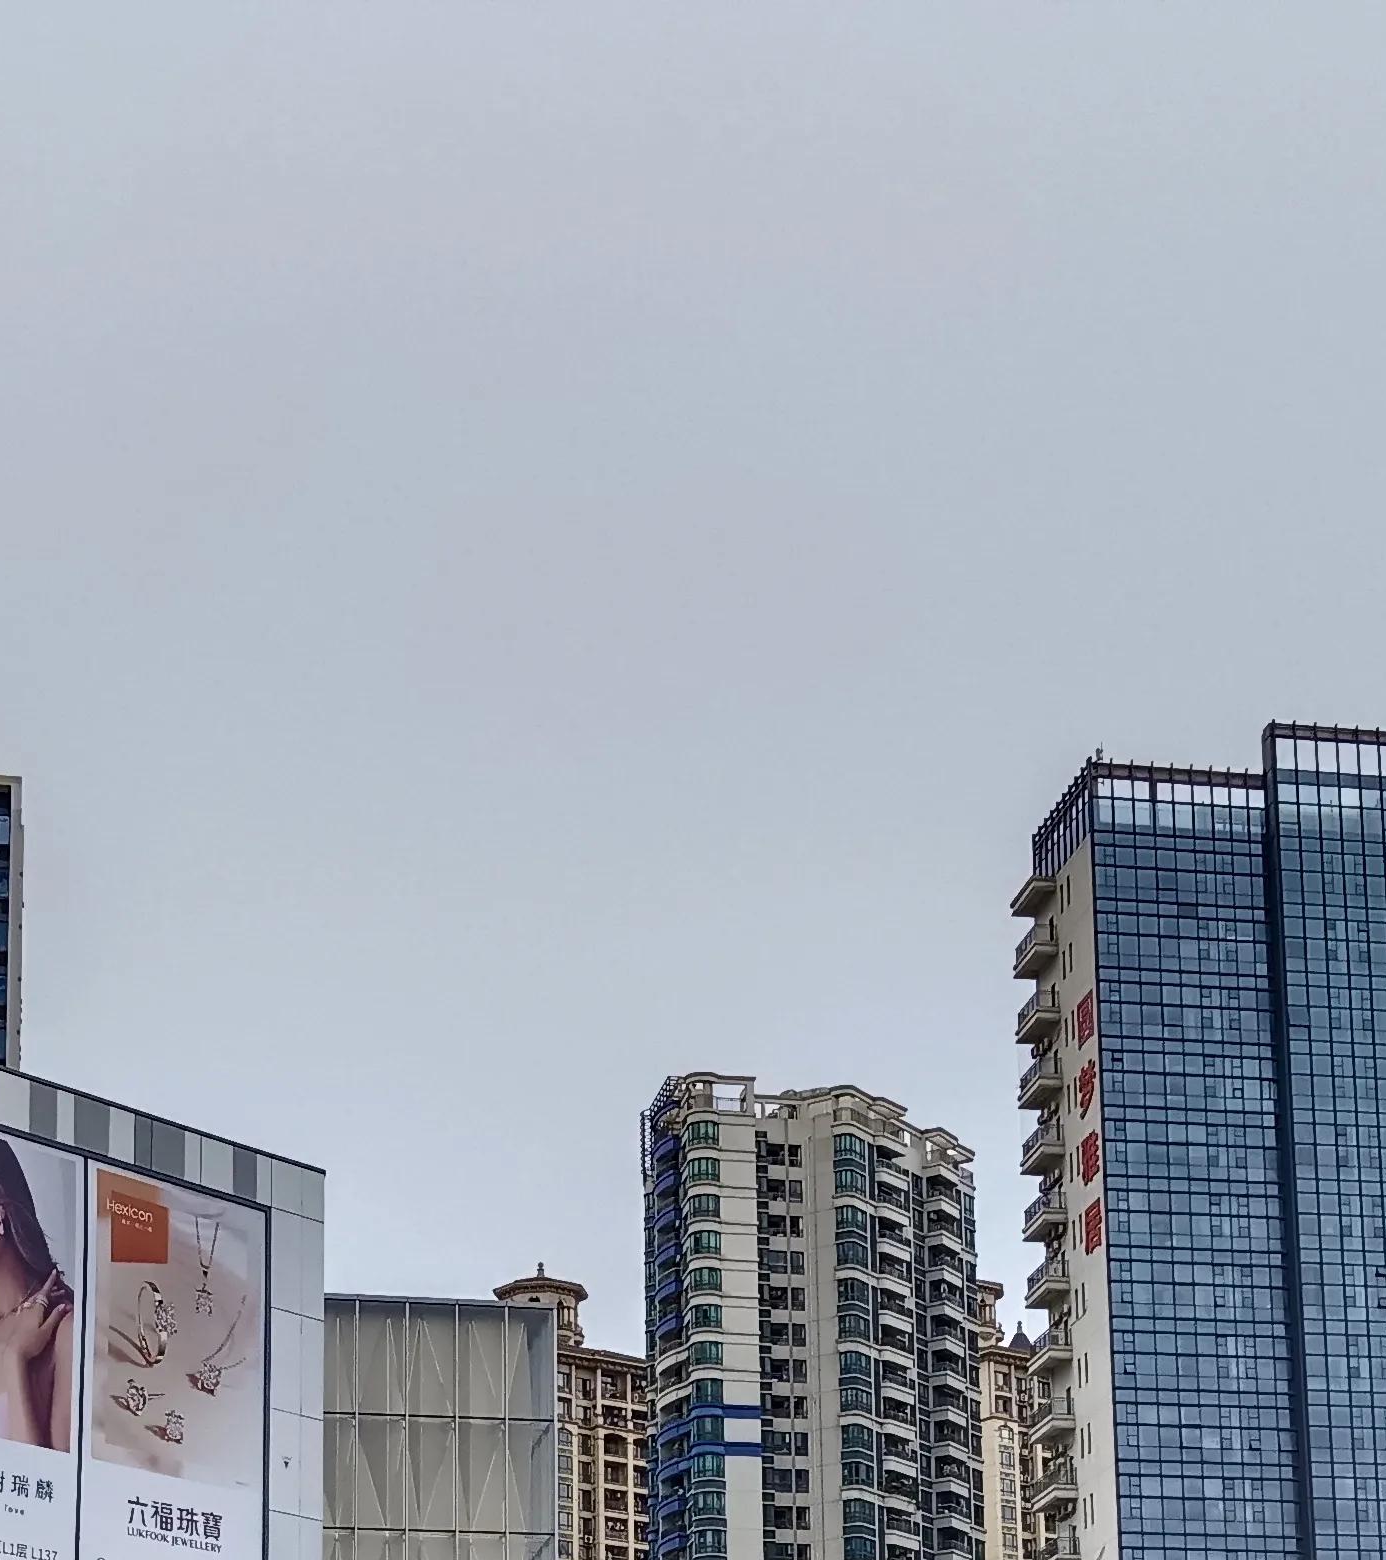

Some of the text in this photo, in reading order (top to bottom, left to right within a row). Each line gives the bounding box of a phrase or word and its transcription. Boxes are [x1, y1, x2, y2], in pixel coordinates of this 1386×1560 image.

[106, 1197, 153, 1222] Hexicon
[4, 1503, 25, 1515] love
[127, 1496, 223, 1542] 六福珠寶
[127, 1526, 223, 1554] LUKFOOK JEWELLERY
